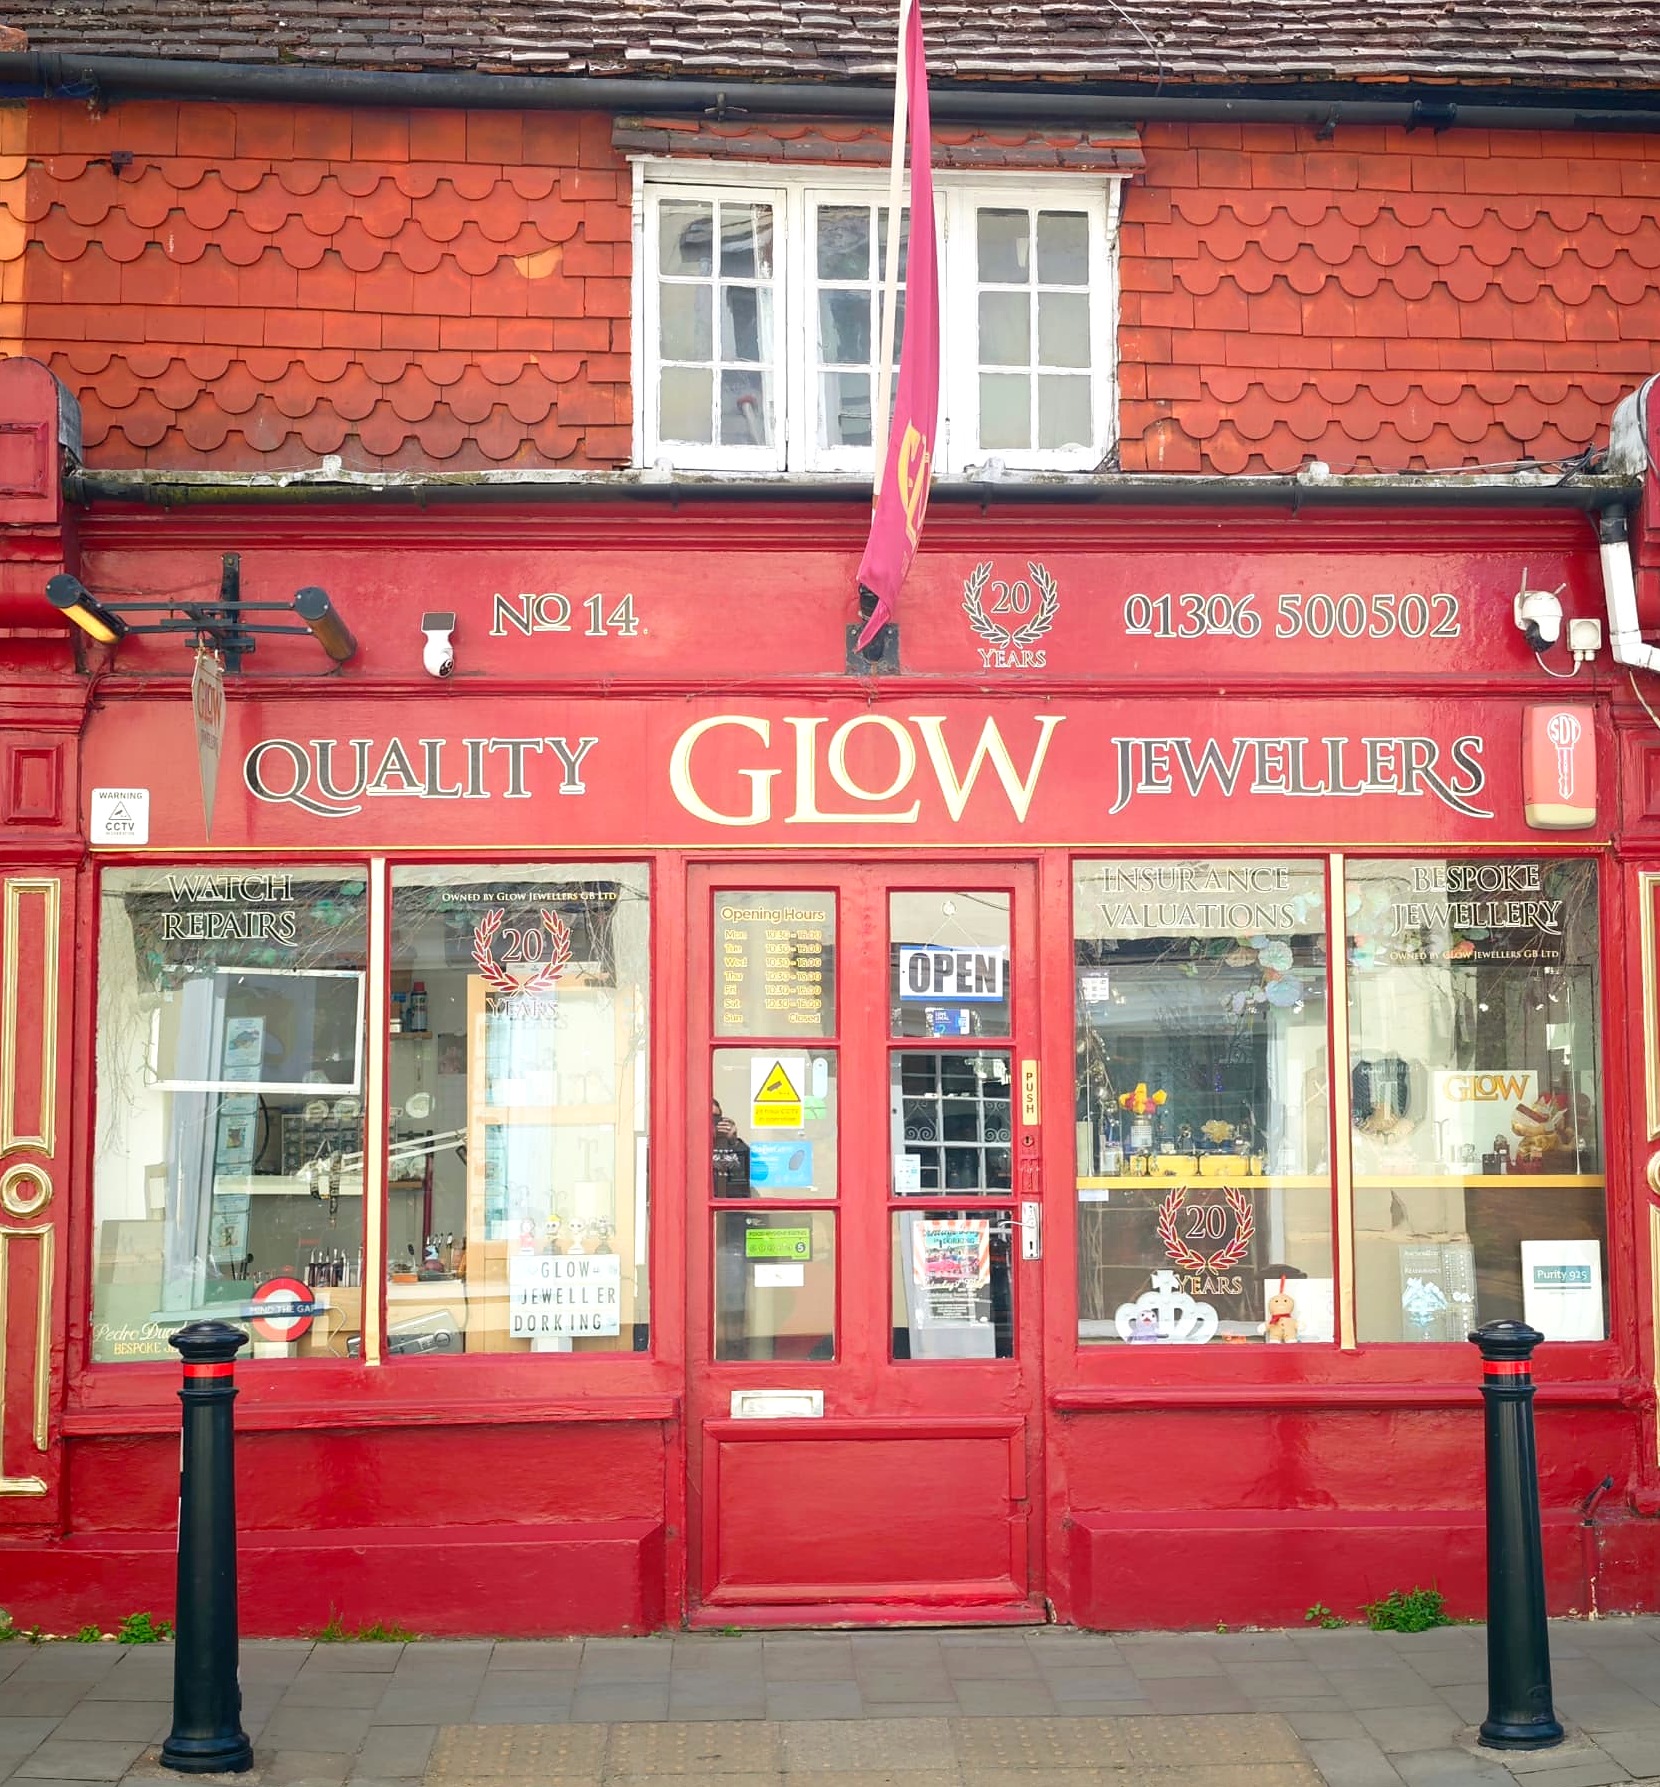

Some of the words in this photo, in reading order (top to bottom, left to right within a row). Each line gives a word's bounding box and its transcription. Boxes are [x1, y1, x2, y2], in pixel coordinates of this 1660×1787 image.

[991, 580, 1031, 615] 20
[583, 593, 639, 636] 14
[1124, 593, 1262, 639] 01306
[1275, 593, 1460, 639] 500502
[978, 648, 1046, 668] YEARS
[243, 736, 598, 818] QUALITY
[669, 714, 1067, 826] GLOW
[1109, 736, 1495, 819] JEWELLERS
[98, 791, 143, 800] WARNING
[105, 822, 135, 831] CCTV
[165, 873, 294, 903] WATCH
[1102, 866, 1289, 893] INSURANCE
[1411, 864, 1540, 893] BESPOKE
[721, 906, 782, 924] Opening
[783, 907, 825, 922] Hours
[1098, 903, 1295, 929] VALUATIONS
[1390, 900, 1563, 936] JEWELLERY
[161, 910, 298, 947] REPAIRS
[500, 927, 544, 963] 20
[908, 952, 997, 994] OPEN
[486, 997, 559, 1018] YEARS
[789, 1013, 821, 1024] Closed
[1026, 1072, 1035, 1114] PUSH
[1443, 1074, 1531, 1102] GLOW
[1185, 1205, 1227, 1239] 20
[797, 1243, 805, 1252] 5
[541, 1261, 589, 1278] GLOW
[1537, 1269, 1567, 1281] Purity
[1569, 1270, 1588, 1281] 925
[1176, 1275, 1243, 1295] YEARS
[93, 1323, 139, 1342] Pedro
[514, 1313, 602, 1332] DORKING
[114, 1343, 162, 1355] BESPOKE
